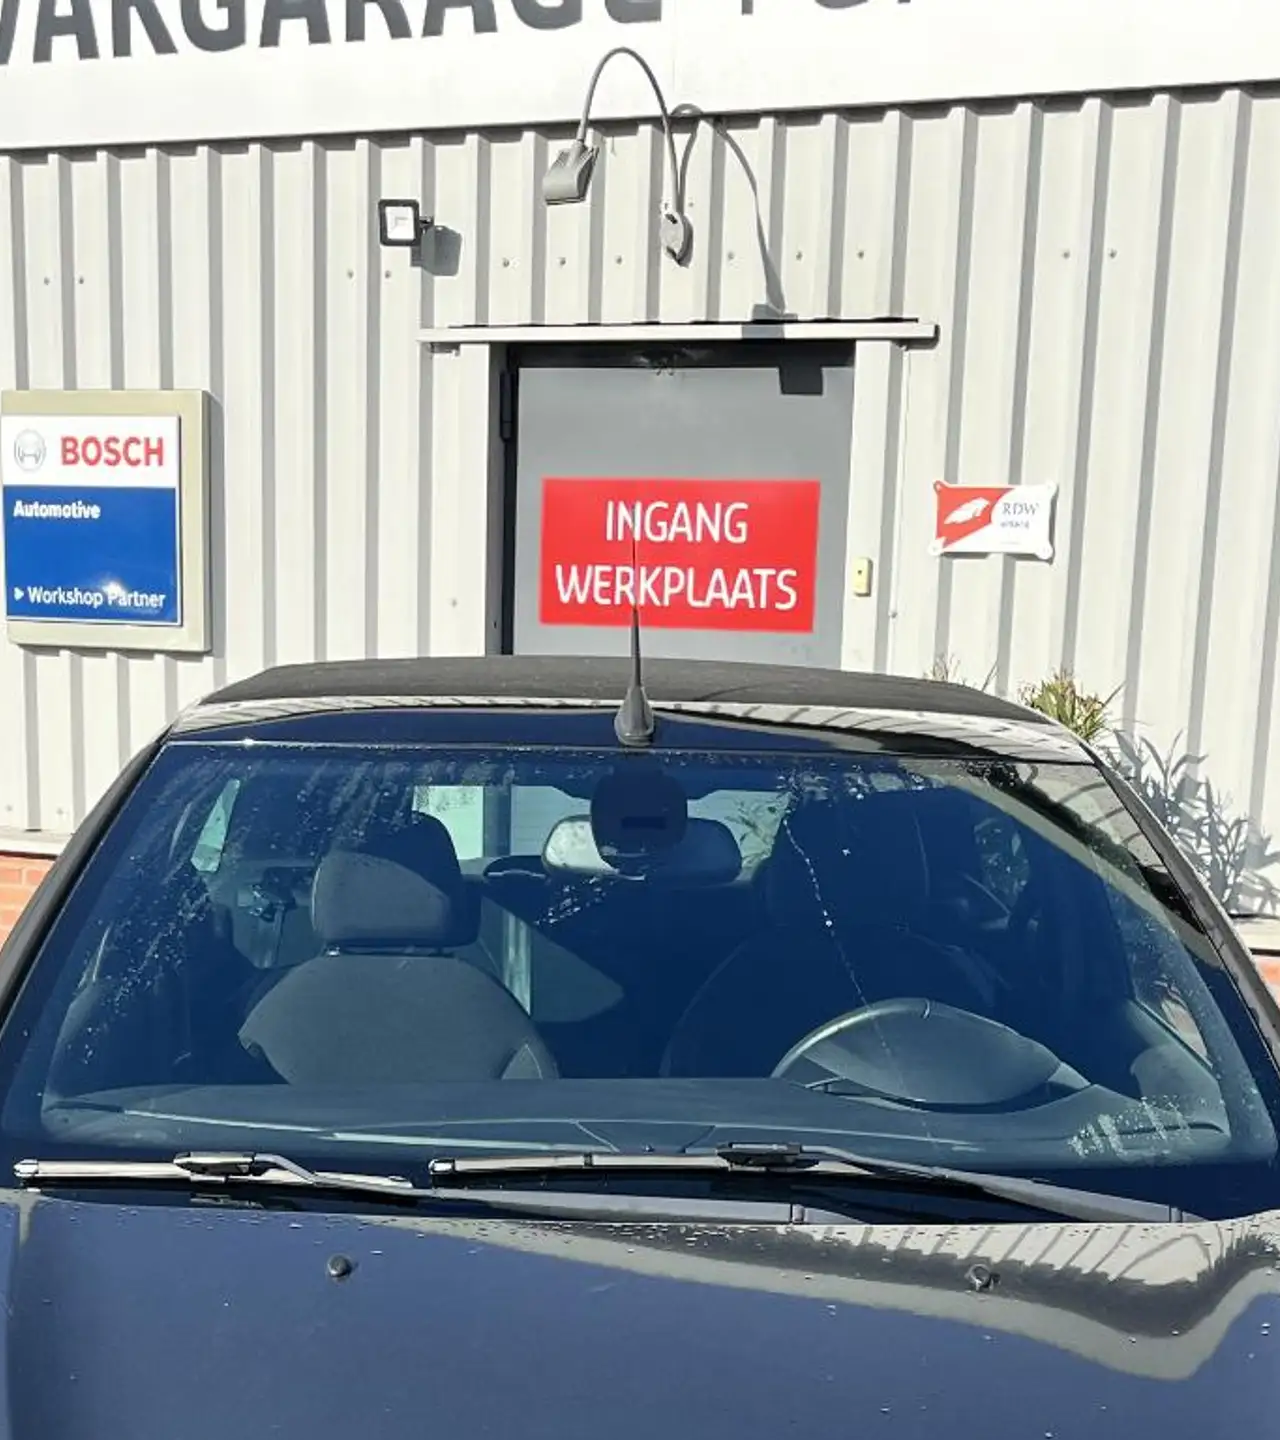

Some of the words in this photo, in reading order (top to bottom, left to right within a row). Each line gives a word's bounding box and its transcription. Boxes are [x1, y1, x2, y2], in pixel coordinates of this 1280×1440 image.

[61, 436, 165, 467] BOSCH
[13, 500, 101, 519] Automotive
[606, 501, 749, 543] INGANG
[27, 586, 103, 608] Workshop
[108, 588, 166, 608] Partner
[555, 564, 798, 610] WERKPLAATS
